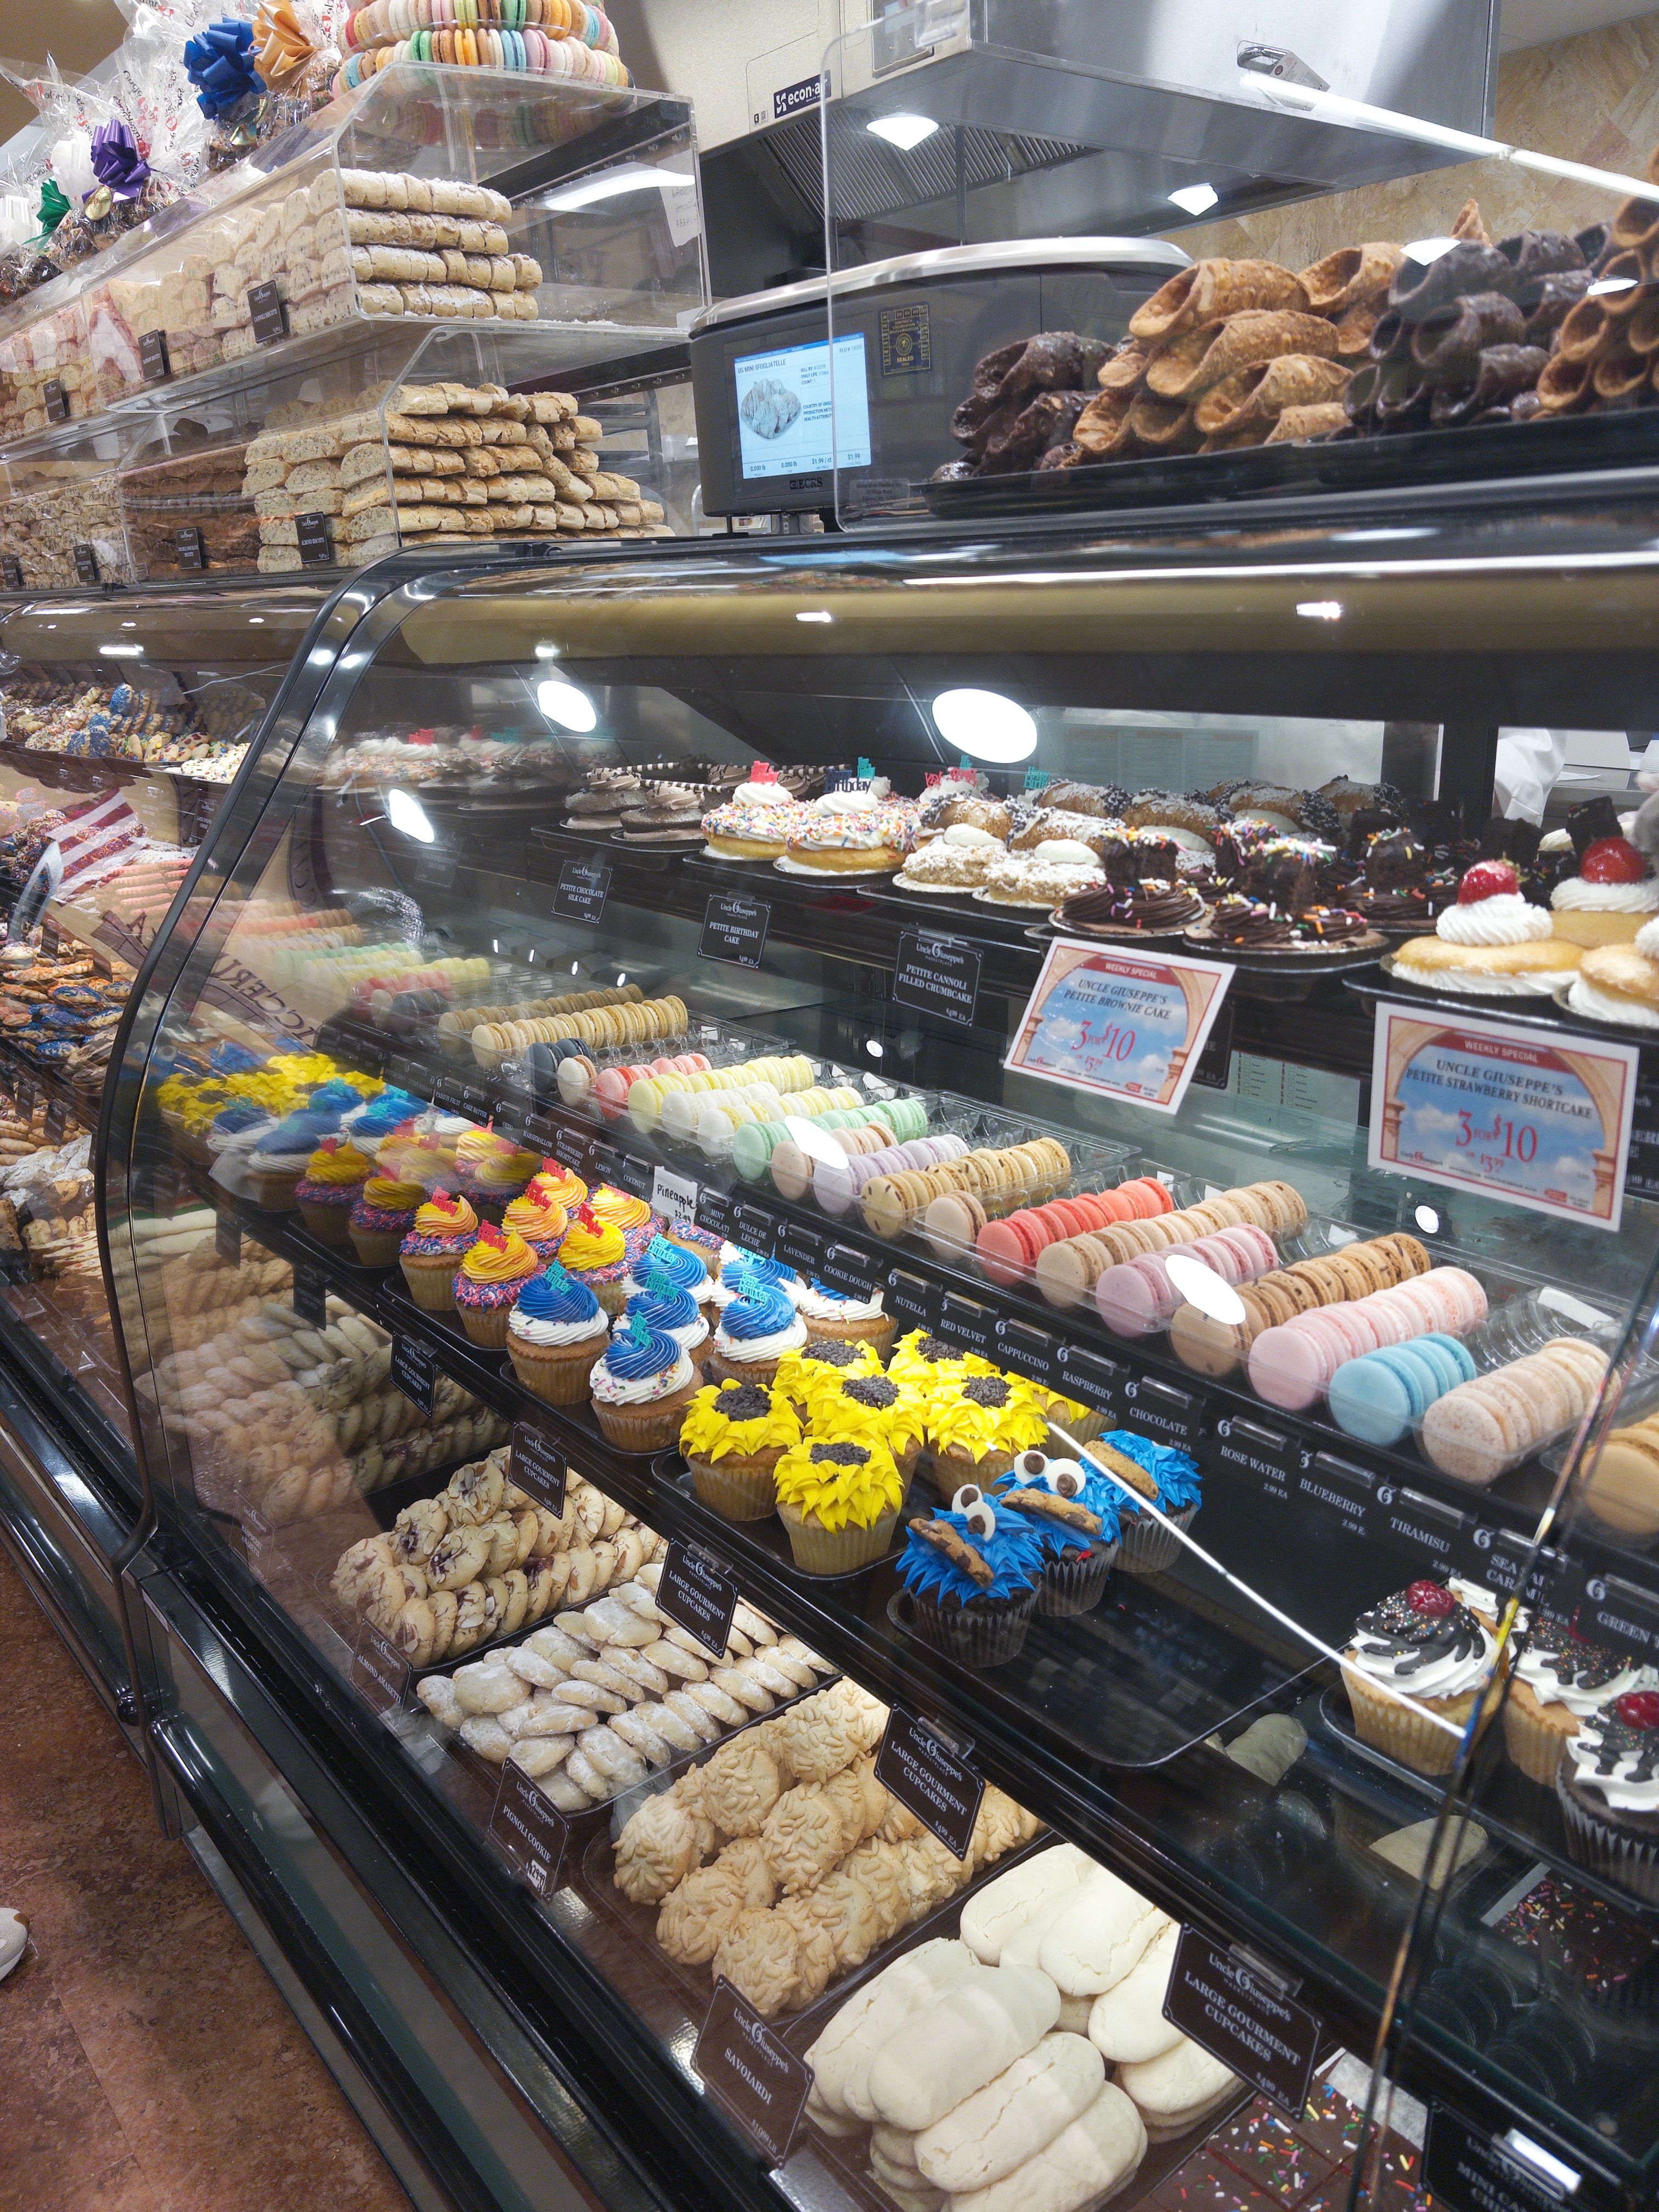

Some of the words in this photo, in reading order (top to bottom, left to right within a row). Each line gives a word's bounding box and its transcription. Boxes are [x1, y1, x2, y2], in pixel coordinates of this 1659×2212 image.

[755, 359, 786, 370] SFOGLIATELLE
[799, 477, 822, 489] ECRS
[560, 883, 577, 892] PETITE
[577, 886, 604, 898] CHOCOLATE
[579, 896, 592, 905] CAKE
[709, 922, 730, 932] PETITE
[730, 926, 760, 939] BIRTHDAY
[724, 935, 740, 945] CAKE
[916, 943, 932, 955] Uncle
[932, 942, 964, 964] Giuseppe's
[906, 963, 933, 980] PETITE
[933, 972, 967, 991] CANNOLI
[1105, 962, 1131, 974] WEEKLY
[1130, 966, 1157, 979] SPECIAL
[898, 973, 925, 989] FILLED
[926, 981, 973, 1005] CRUMBCAKE
[1078, 979, 1110, 994] UNCLE
[1110, 985, 1169, 1005] GIUSEPPE'S
[1063, 990, 1097, 1004] PETITE
[1097, 996, 1143, 1014] BROWNIE
[1144, 1006, 1172, 1020] CAKE
[958, 1013, 966, 1022] EA
[1071, 1018, 1093, 1051] 3
[1102, 1021, 1137, 1062] $10
[1464, 1040, 1499, 1055] WEEKLY
[1500, 1048, 1538, 1063] SPECIAL
[1436, 1059, 1481, 1078] UNCLE
[1483, 1070, 1564, 1096] GIUSEPPE'S
[435, 1091, 450, 1102] PASSION
[450, 1097, 461, 1107] FRUIT
[1406, 1068, 1444, 1086] PETITE
[1446, 1077, 1521, 1103] STRAWBERRY
[1522, 1093, 1593, 1119] SHORTCAKE
[463, 1103, 473, 1112] CAKE
[472, 1107, 487, 1118] BATTER
[523, 1130, 554, 1148] MARSHMALLOW
[1456, 1107, 1472, 1147] 3
[1493, 1114, 1538, 1163] $10
[556, 1140, 584, 1159] STRAWBERRY
[556, 1149, 580, 1167] SHORTCAKE
[595, 1163, 612, 1175] LEMON
[623, 1174, 646, 1189] COCONUT
[710, 1208, 725, 1220] MINT
[739, 1221, 759, 1235] DULCE
[758, 1229, 767, 1239] DE
[741, 1233, 760, 1248] LECHE
[783, 1244, 816, 1265] LAVENDER
[824, 1264, 848, 1280] COOKIE
[849, 1274, 872, 1291] DOUGH
[854, 1293, 862, 1301] 2.99
[862, 1296, 869, 1304] EA
[895, 1295, 927, 1317] NUTELLA
[940, 1318, 956, 1333] RED
[957, 1324, 986, 1344] VELVET
[997, 1341, 1049, 1372] CAPPUCCINO
[1031, 1374, 1042, 1383] 2.99
[1062, 1370, 1113, 1401] RASPBERRY
[1096, 1404, 1107, 1414] 2.99
[1108, 1410, 1117, 1420] EA
[1129, 1407, 1187, 1435] CHOCOLATE
[1168, 1437, 1181, 1448] 2.99
[1181, 1443, 1192, 1453] EA
[515, 1450, 532, 1466] LARGE
[1221, 1446, 1248, 1465] ROSE
[1249, 1457, 1286, 1482] WATER
[524, 1465, 550, 1489] CUPCAKES
[1263, 1482, 1277, 1494] 2.99
[1277, 1490, 1288, 1499] EA
[1299, 1478, 1366, 1518] BLUEBERRY
[1342, 1519, 1357, 1530] 2.99
[1390, 1516, 1451, 1553] TIRAMISU
[682, 1555, 695, 1570] Uncle
[1432, 1559, 1448, 1573] 2.99
[1449, 1567, 1463, 1580] EA
[1490, 1553, 1517, 1575] SEA
[669, 1570, 689, 1592] LARGE
[690, 1587, 726, 1620] GOURMENT
[678, 1590, 711, 1622] CUPCAKES
[1597, 1611, 1651, 1644] GREEN
[711, 1639, 718, 1649] EA
[357, 1654, 378, 1678] ALMOND
[377, 1674, 402, 1703] AMARETTI
[909, 1727, 927, 1748] Uncle
[926, 1738, 963, 1782] Giuseppe's
[890, 1740, 918, 1771] LARGE
[919, 1767, 967, 1816] GOURMENT
[903, 1767, 947, 1813] CUPCAKES
[516, 1781, 529, 1799] Uncle
[528, 1790, 555, 1827] Giuseppe's
[503, 1804, 528, 1838] PIGNOLI
[528, 1830, 552, 1863] COOKIE
[948, 1835, 957, 1848] EA
[1209, 1952, 1235, 1980] Uncle
[1184, 1970, 1226, 2011] LARGE
[1227, 2004, 1301, 2066] GOURMENT
[733, 2007, 752, 2033] Uncle
[751, 2022, 790, 2074] Giuseppe's
[1205, 2003, 1272, 2062] CUPCAKES
[724, 2047, 773, 2105] SAVOIARDI
[1277, 2085, 1290, 2106] EA
